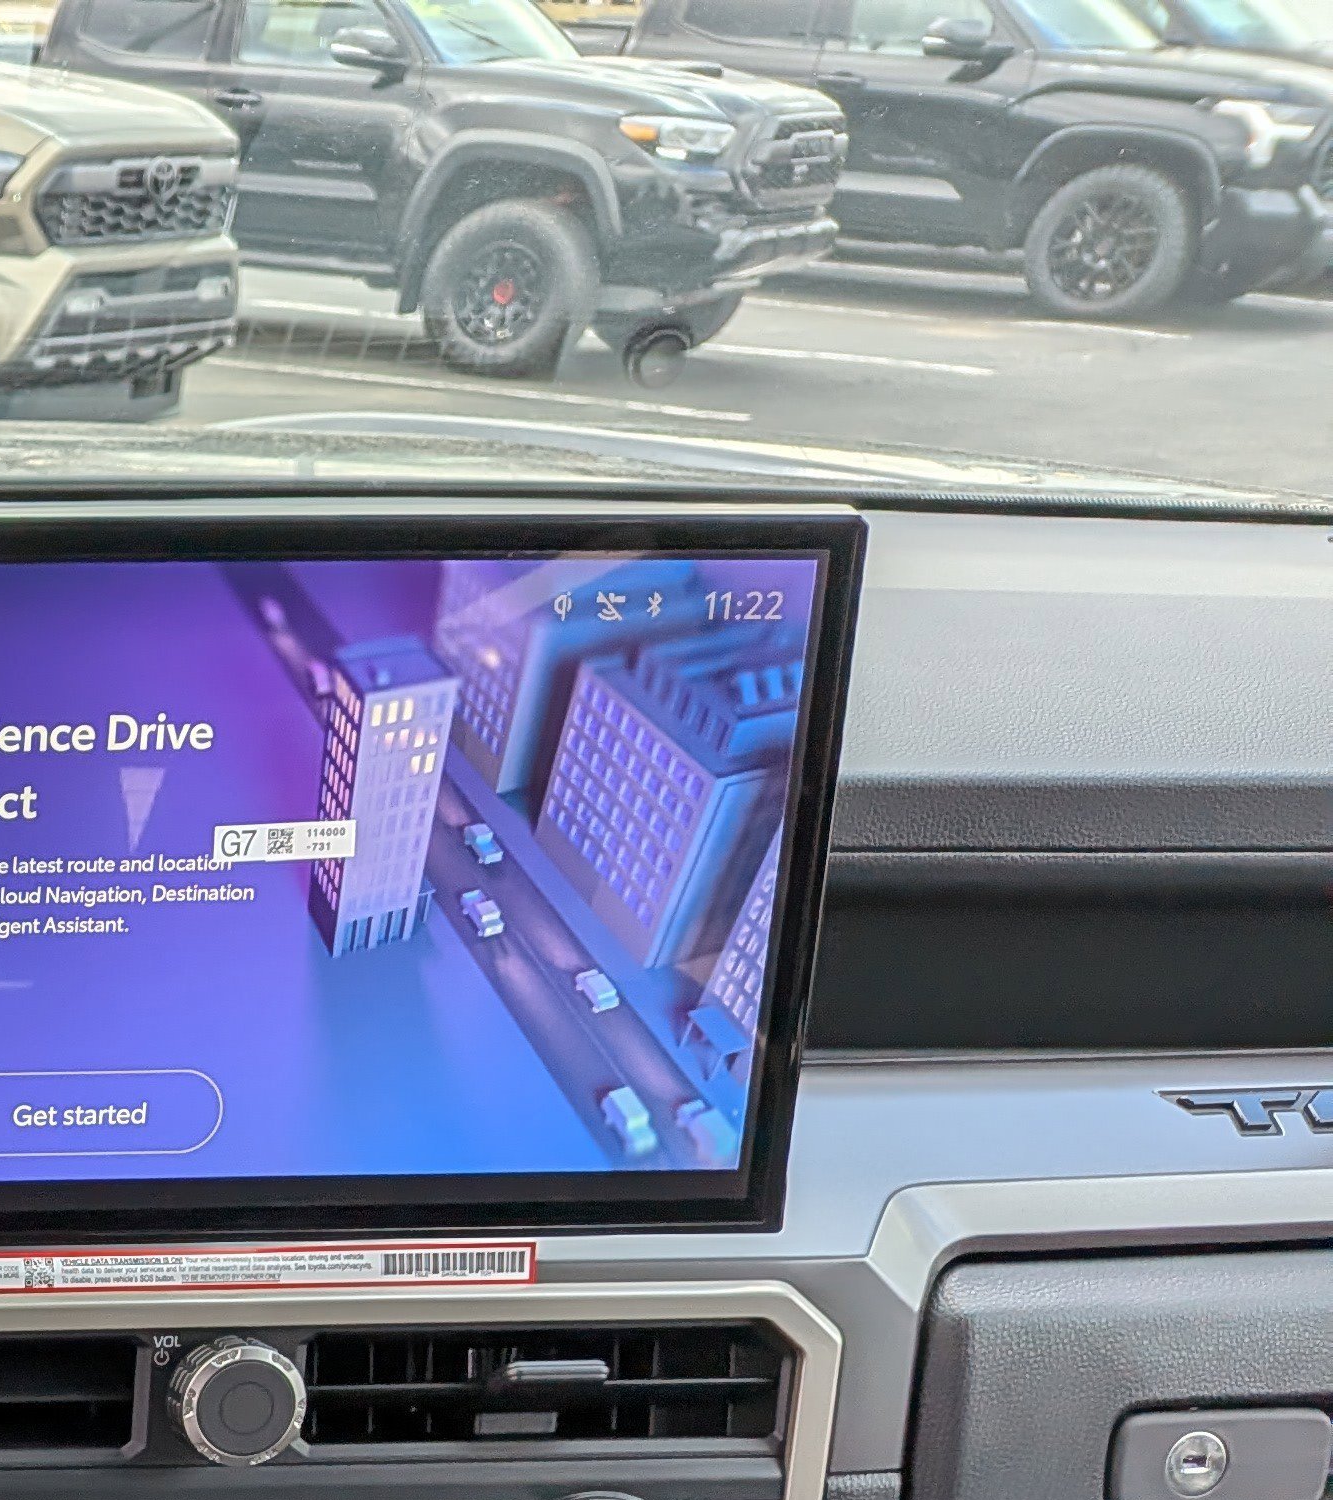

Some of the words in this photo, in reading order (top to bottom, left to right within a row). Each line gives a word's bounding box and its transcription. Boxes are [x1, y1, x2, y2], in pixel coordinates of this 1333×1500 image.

[705, 592, 784, 620] 11:22
[107, 713, 214, 752] Drive
[221, 830, 257, 857] G7
[12, 856, 63, 874] latest
[67, 857, 115, 874] route
[119, 855, 153, 873] and
[158, 854, 232, 872] location
[45, 886, 146, 908] Navigation,
[152, 884, 255, 902] Destination
[43, 916, 129, 934] Assistant.
[13, 1101, 56, 1127] Get
[63, 1100, 147, 1126] started
[154, 1336, 181, 1348] VOL
